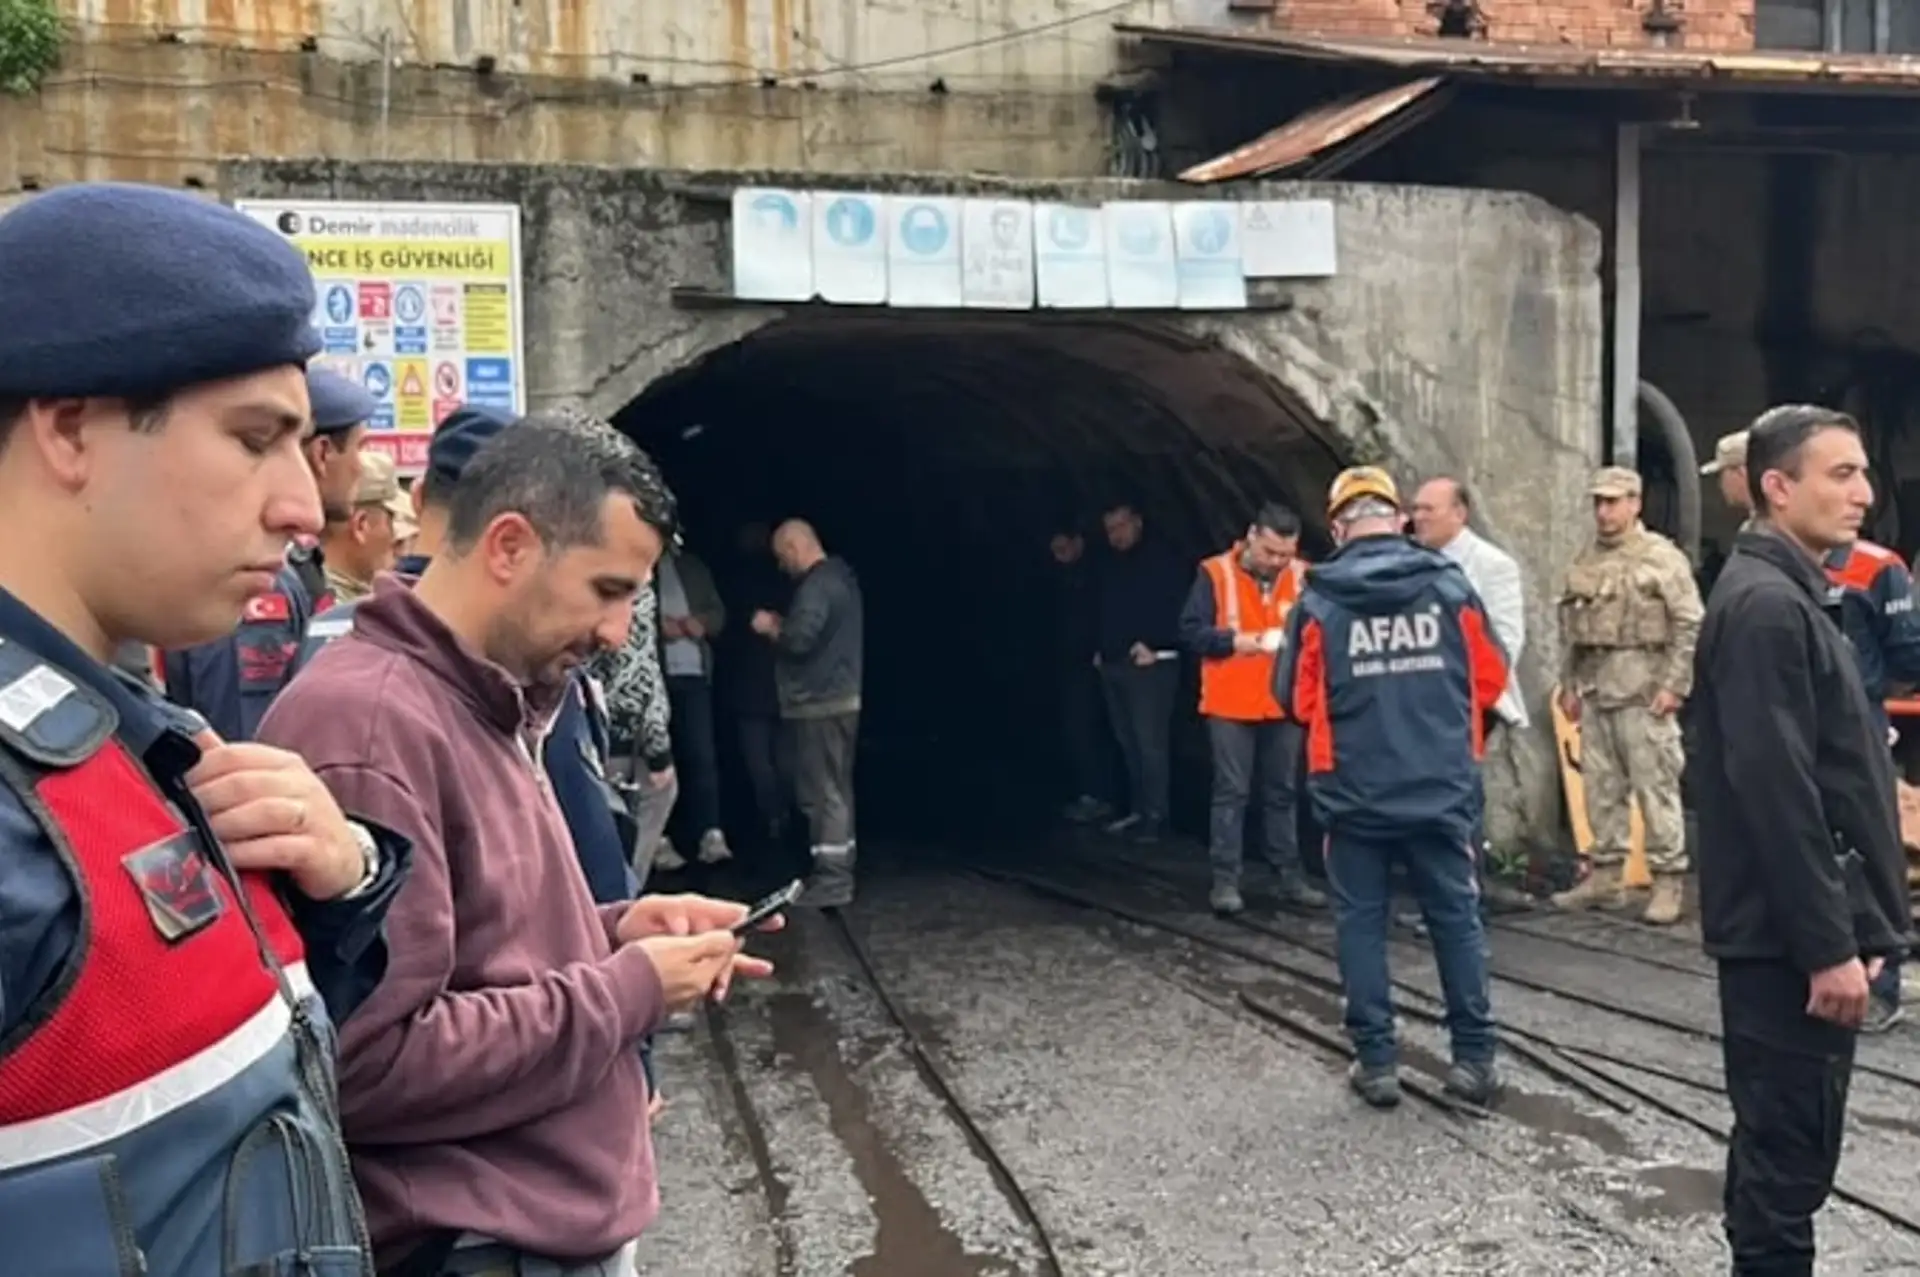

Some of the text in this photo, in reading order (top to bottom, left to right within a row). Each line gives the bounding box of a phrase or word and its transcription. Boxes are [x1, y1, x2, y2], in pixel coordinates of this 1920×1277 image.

[309, 216, 480, 236] Demir madencilik
[308, 245, 494, 273] NCE İŞ GÜVENLİĞİ
[1348, 612, 1440, 657] AFAD
